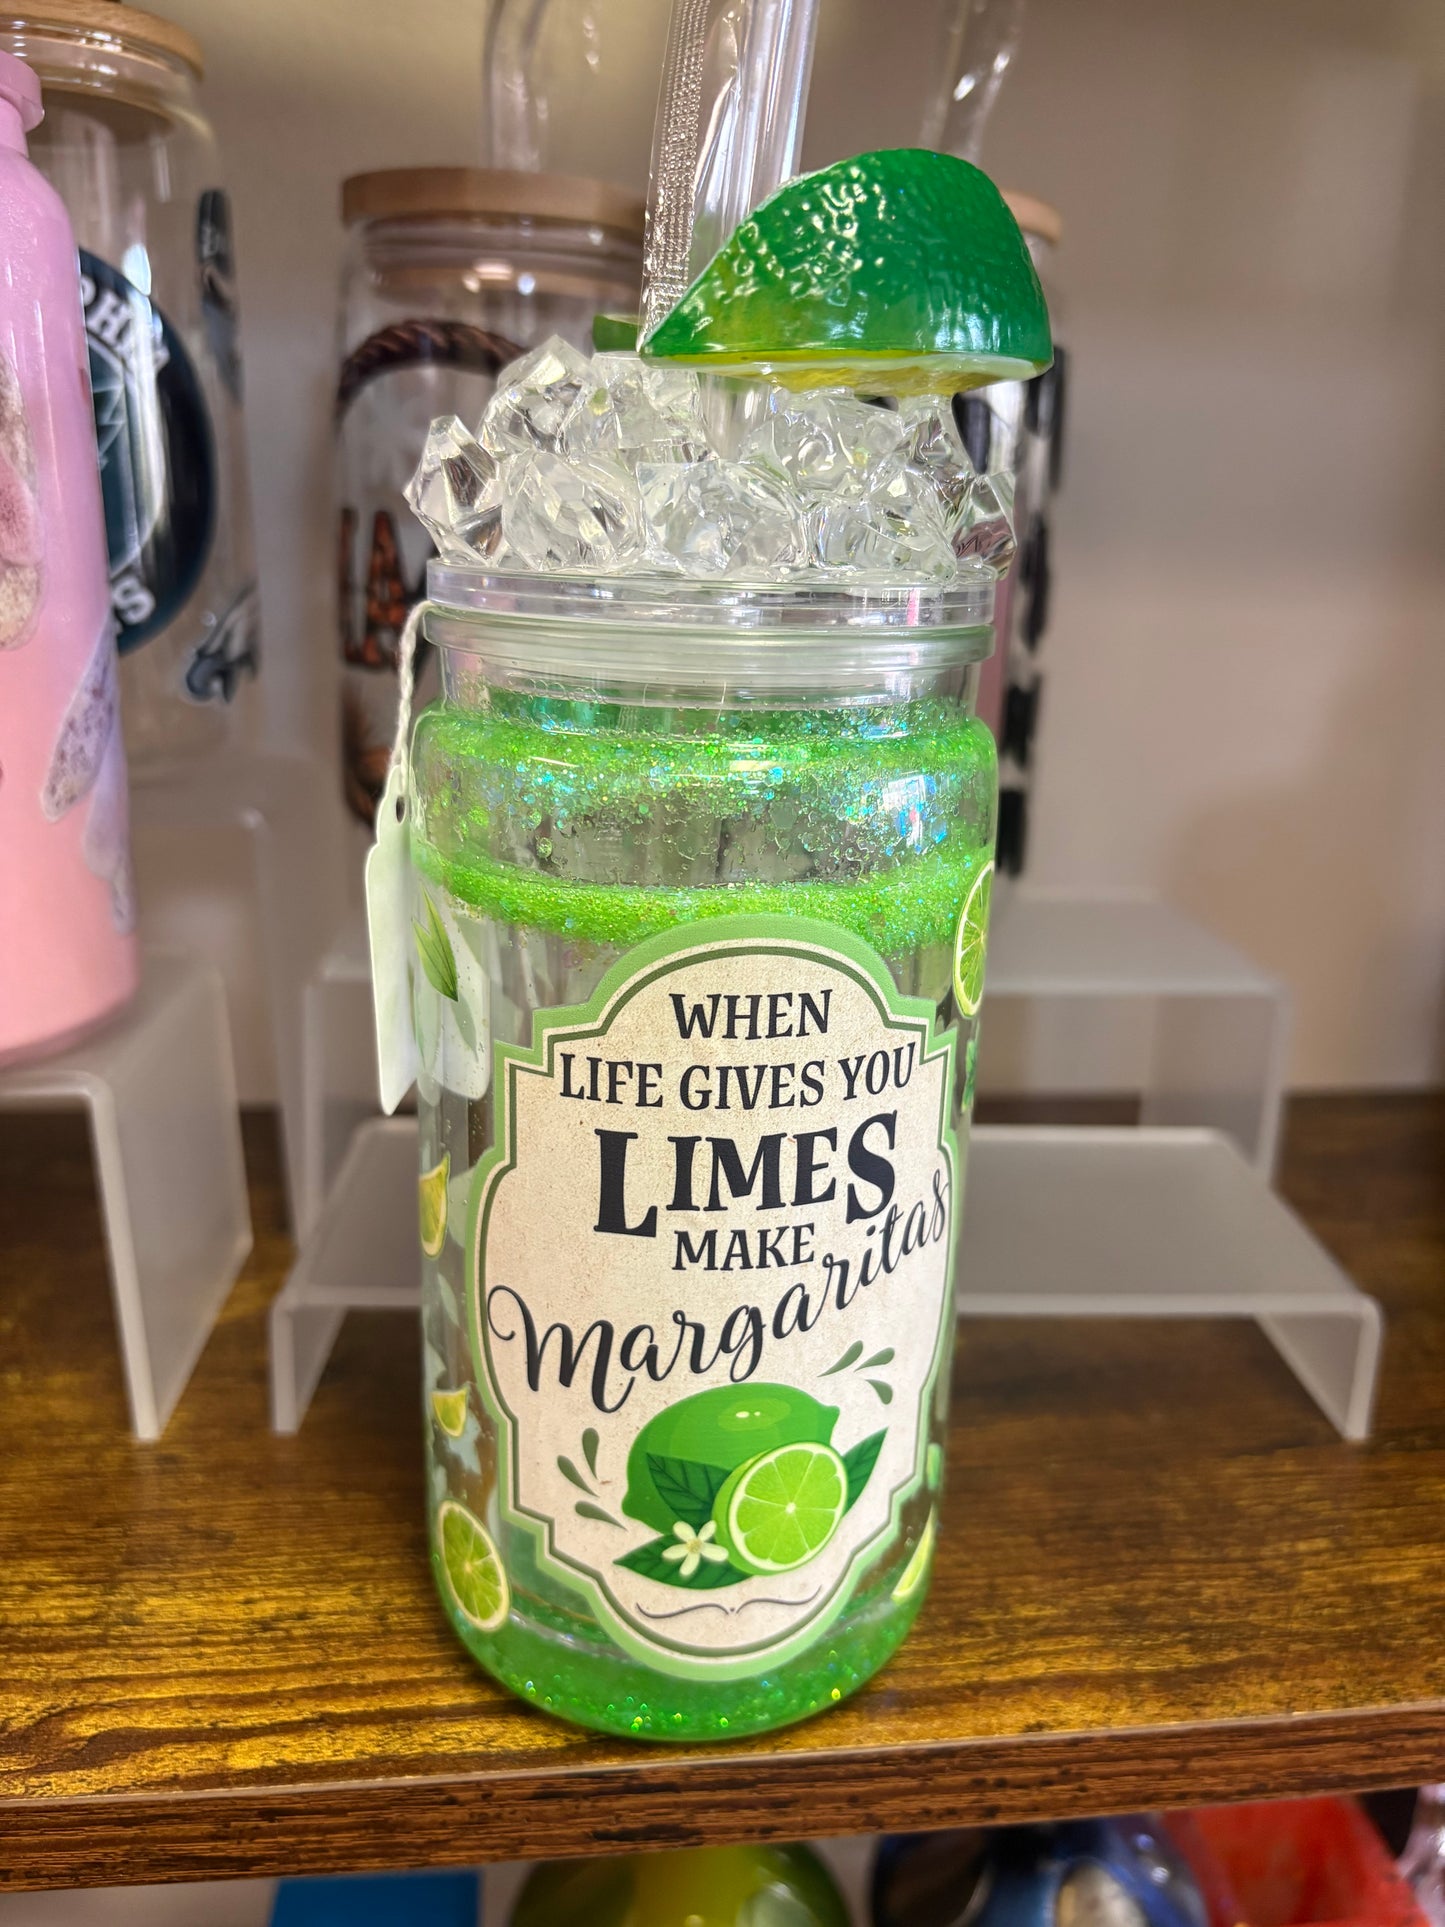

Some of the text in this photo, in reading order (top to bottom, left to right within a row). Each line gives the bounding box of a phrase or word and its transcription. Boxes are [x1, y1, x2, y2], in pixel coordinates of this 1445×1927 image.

[669, 989, 832, 1040] WHEN
[559, 1042, 916, 1111] LIFE GIVES YOU
[593, 1109, 898, 1238] LIMES
[671, 1223, 815, 1272] MAKE
